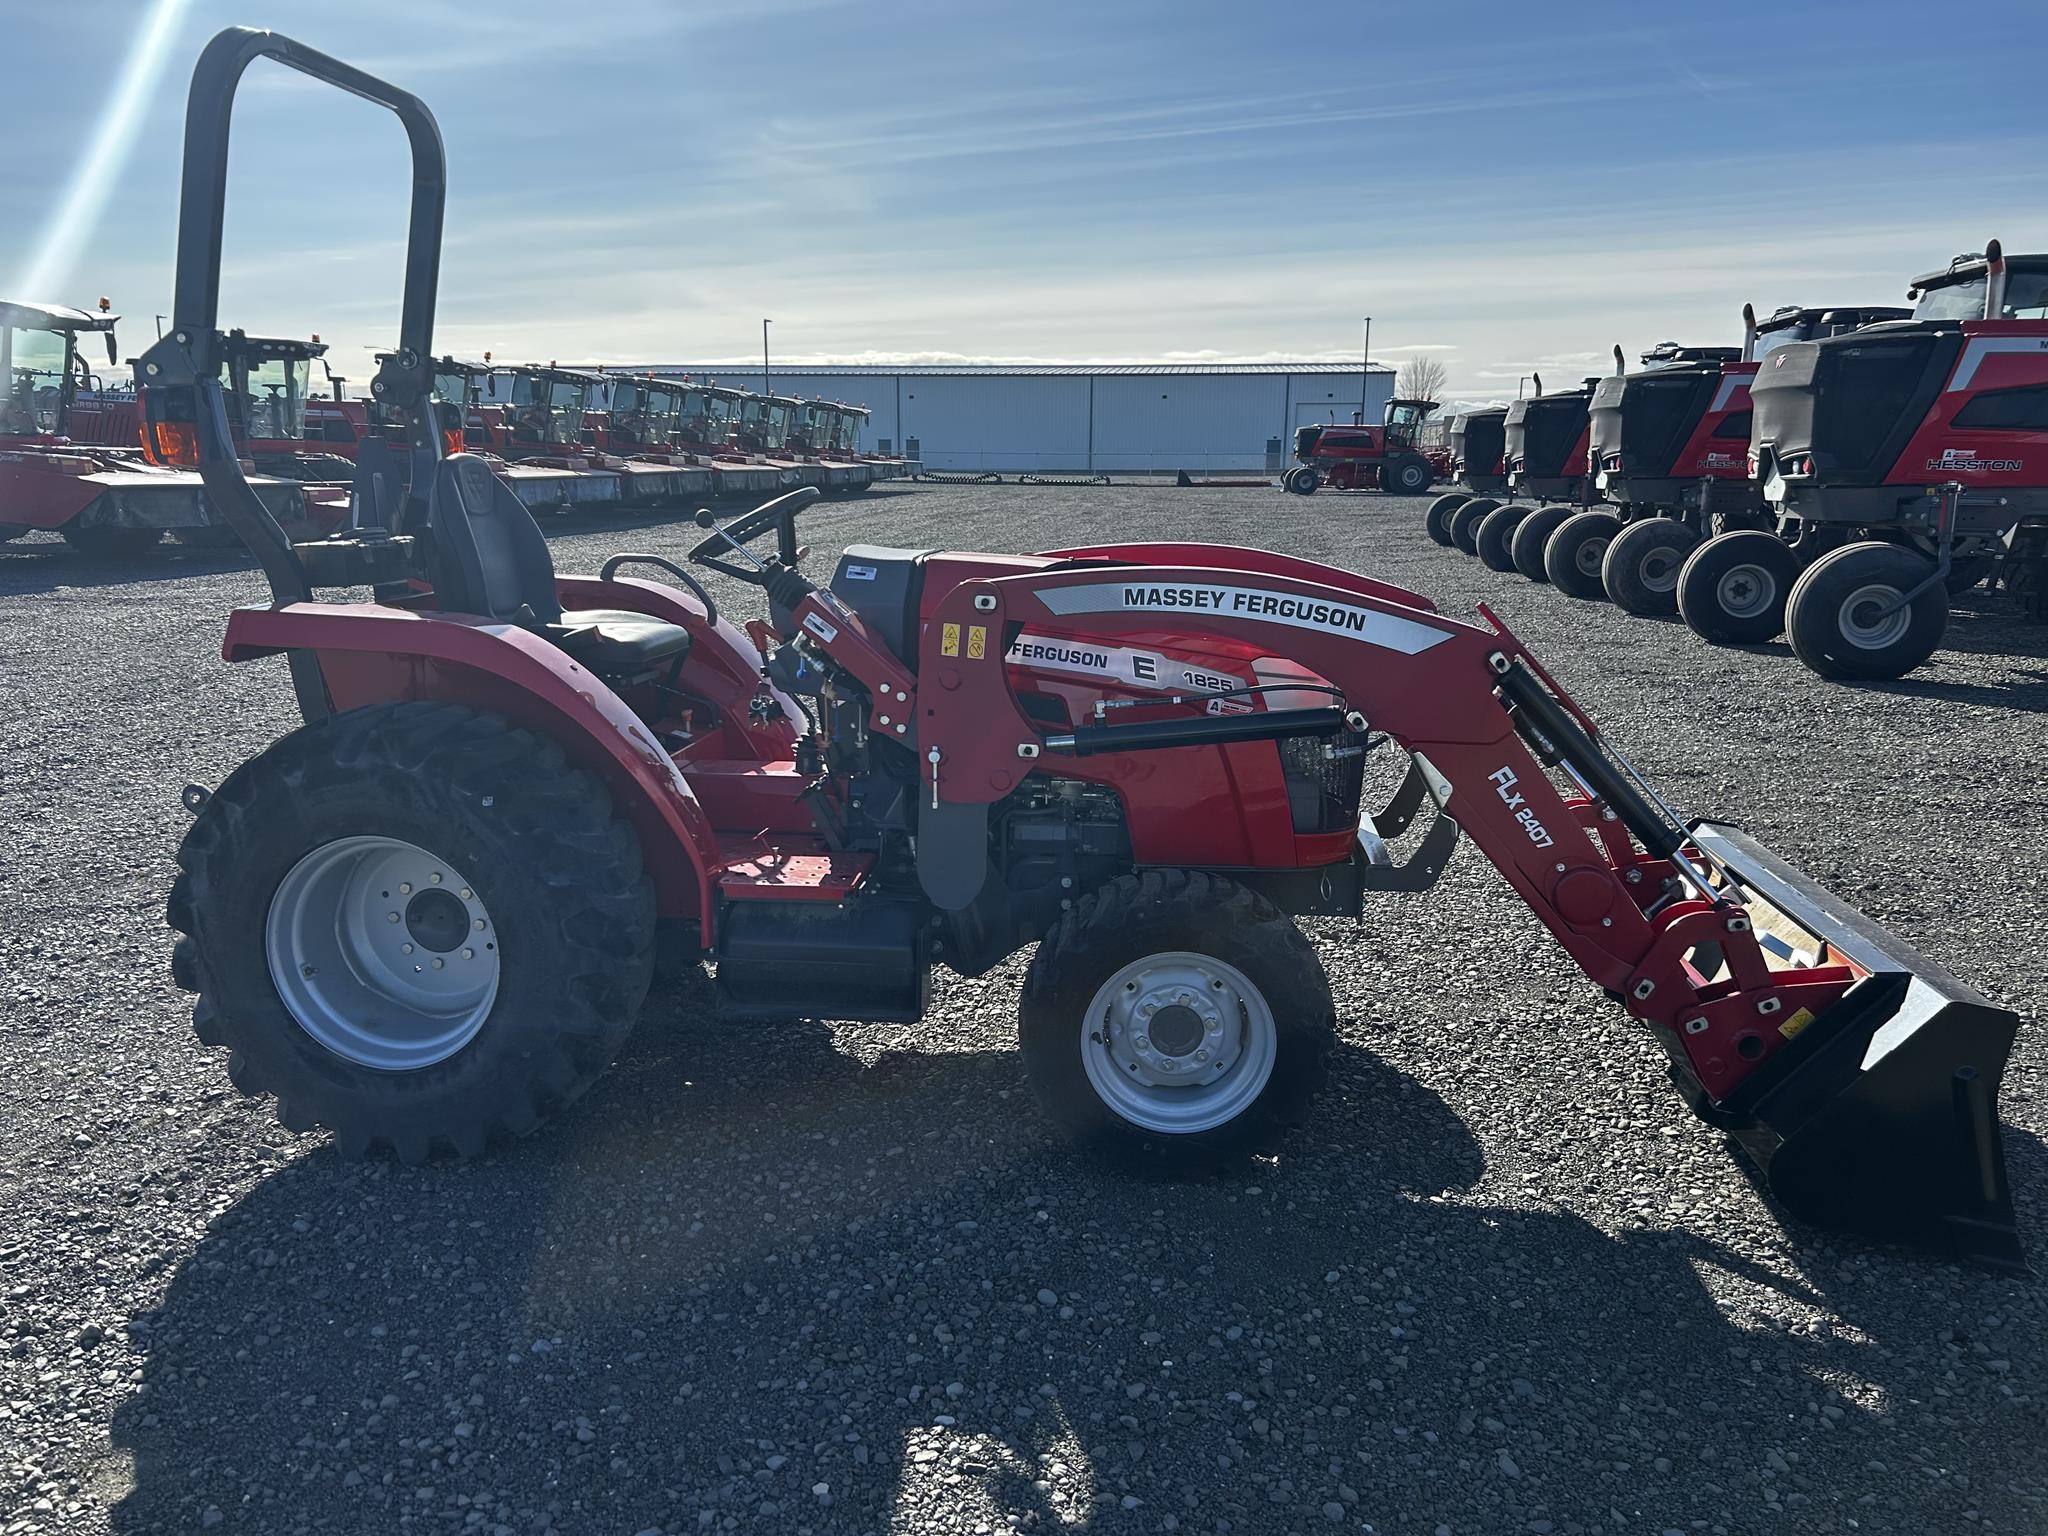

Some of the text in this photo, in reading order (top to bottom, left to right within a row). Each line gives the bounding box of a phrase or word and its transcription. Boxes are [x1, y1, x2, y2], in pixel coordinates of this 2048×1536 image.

[1696, 459, 1749, 469] HESSTO
[1926, 459, 2022, 471] HESSTON
[1124, 588, 1366, 631] MASSEY FERGUSON
[1011, 643, 1233, 691] FERGUSON E 1825
[1487, 765, 1554, 848] FLX 2407
